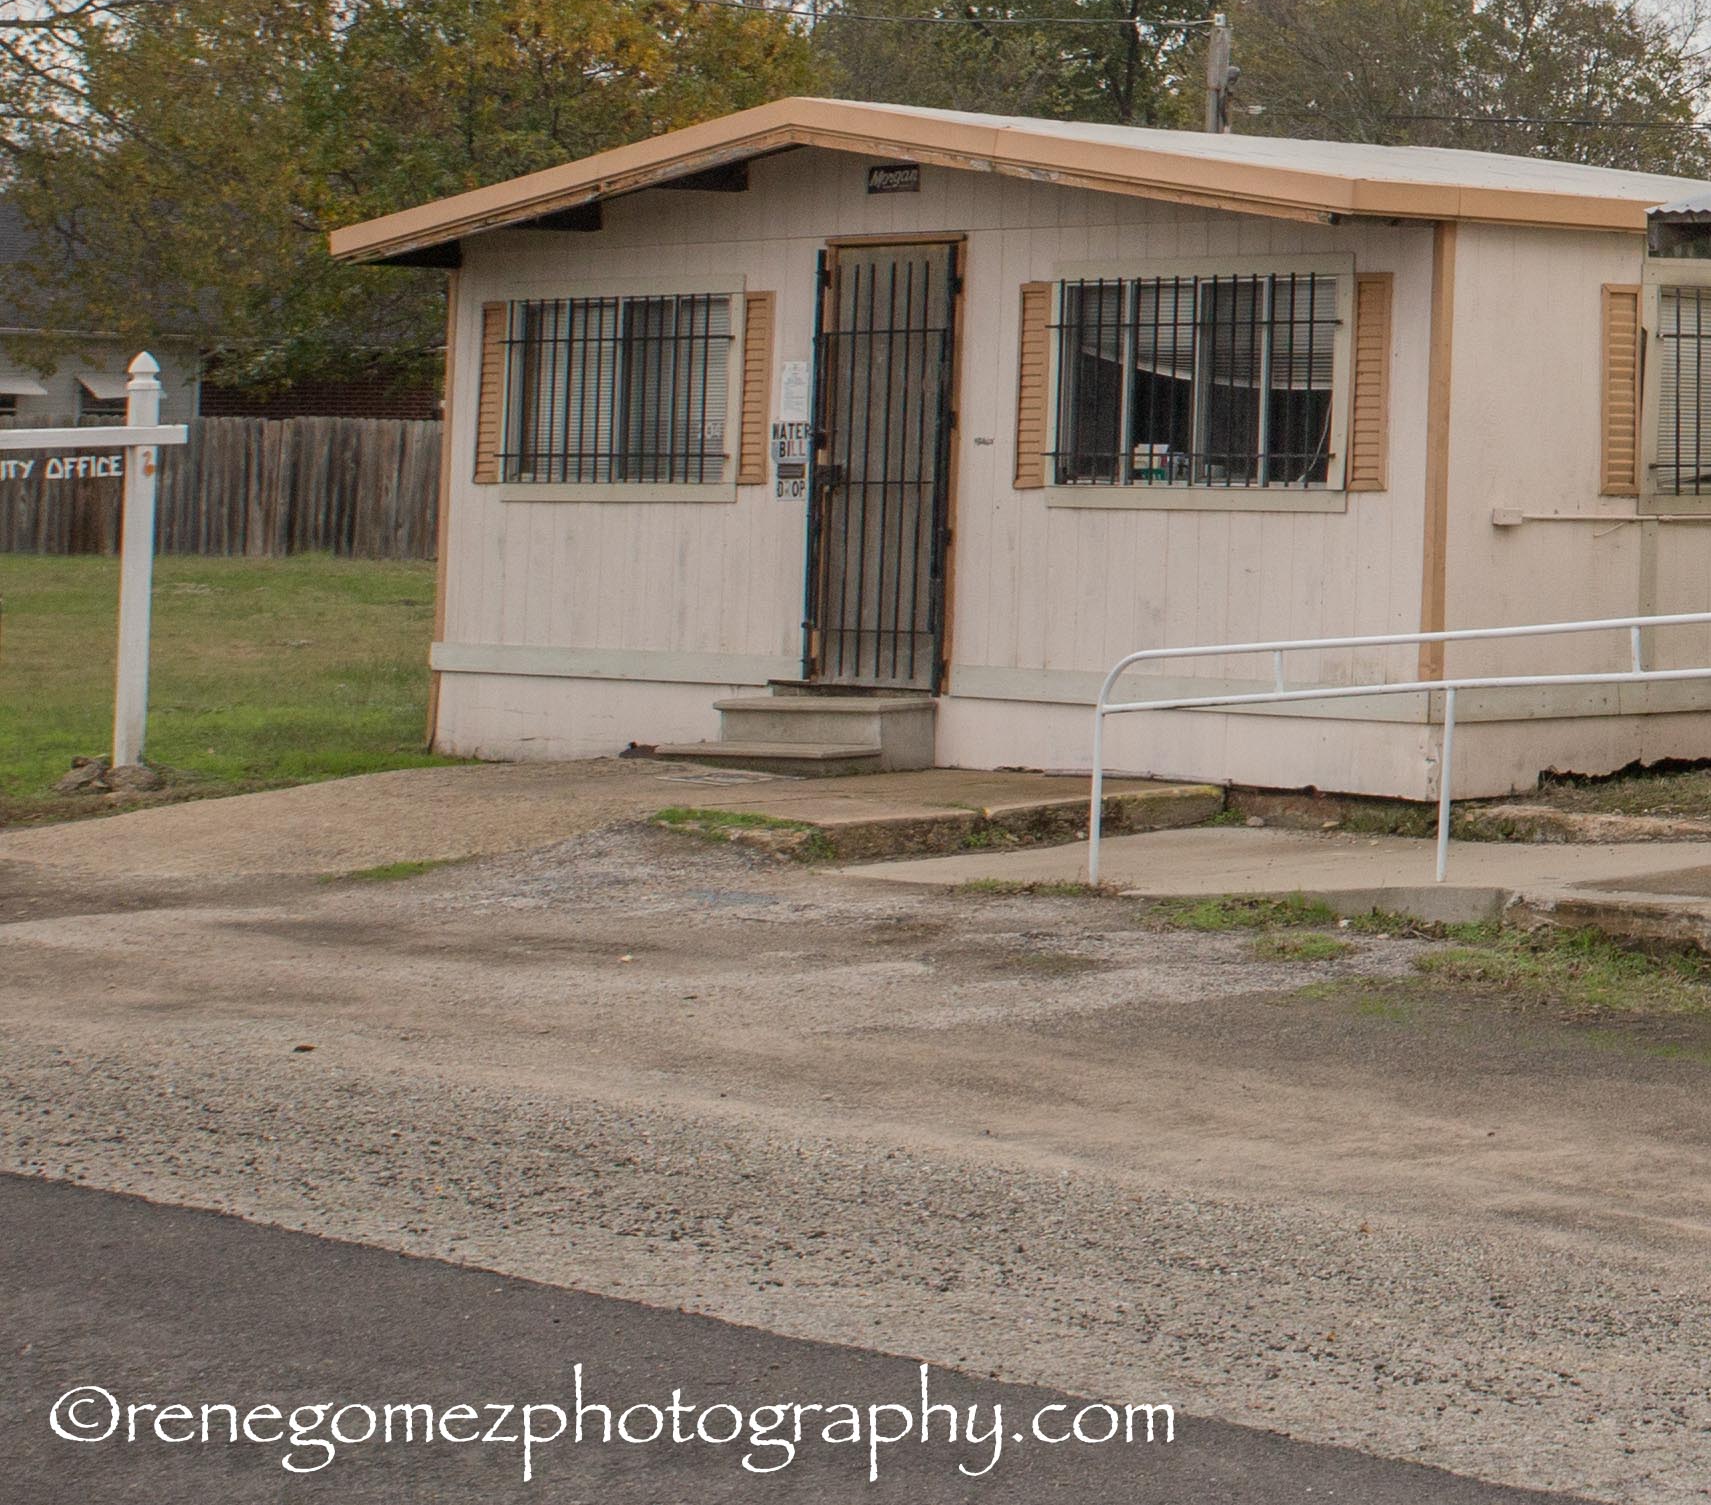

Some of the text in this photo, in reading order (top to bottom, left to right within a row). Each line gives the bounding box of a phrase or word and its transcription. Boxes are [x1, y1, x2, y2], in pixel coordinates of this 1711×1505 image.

[772, 422, 812, 441] WATER
[779, 440, 806, 458] BILL
[46, 455, 125, 480] OFFICE
